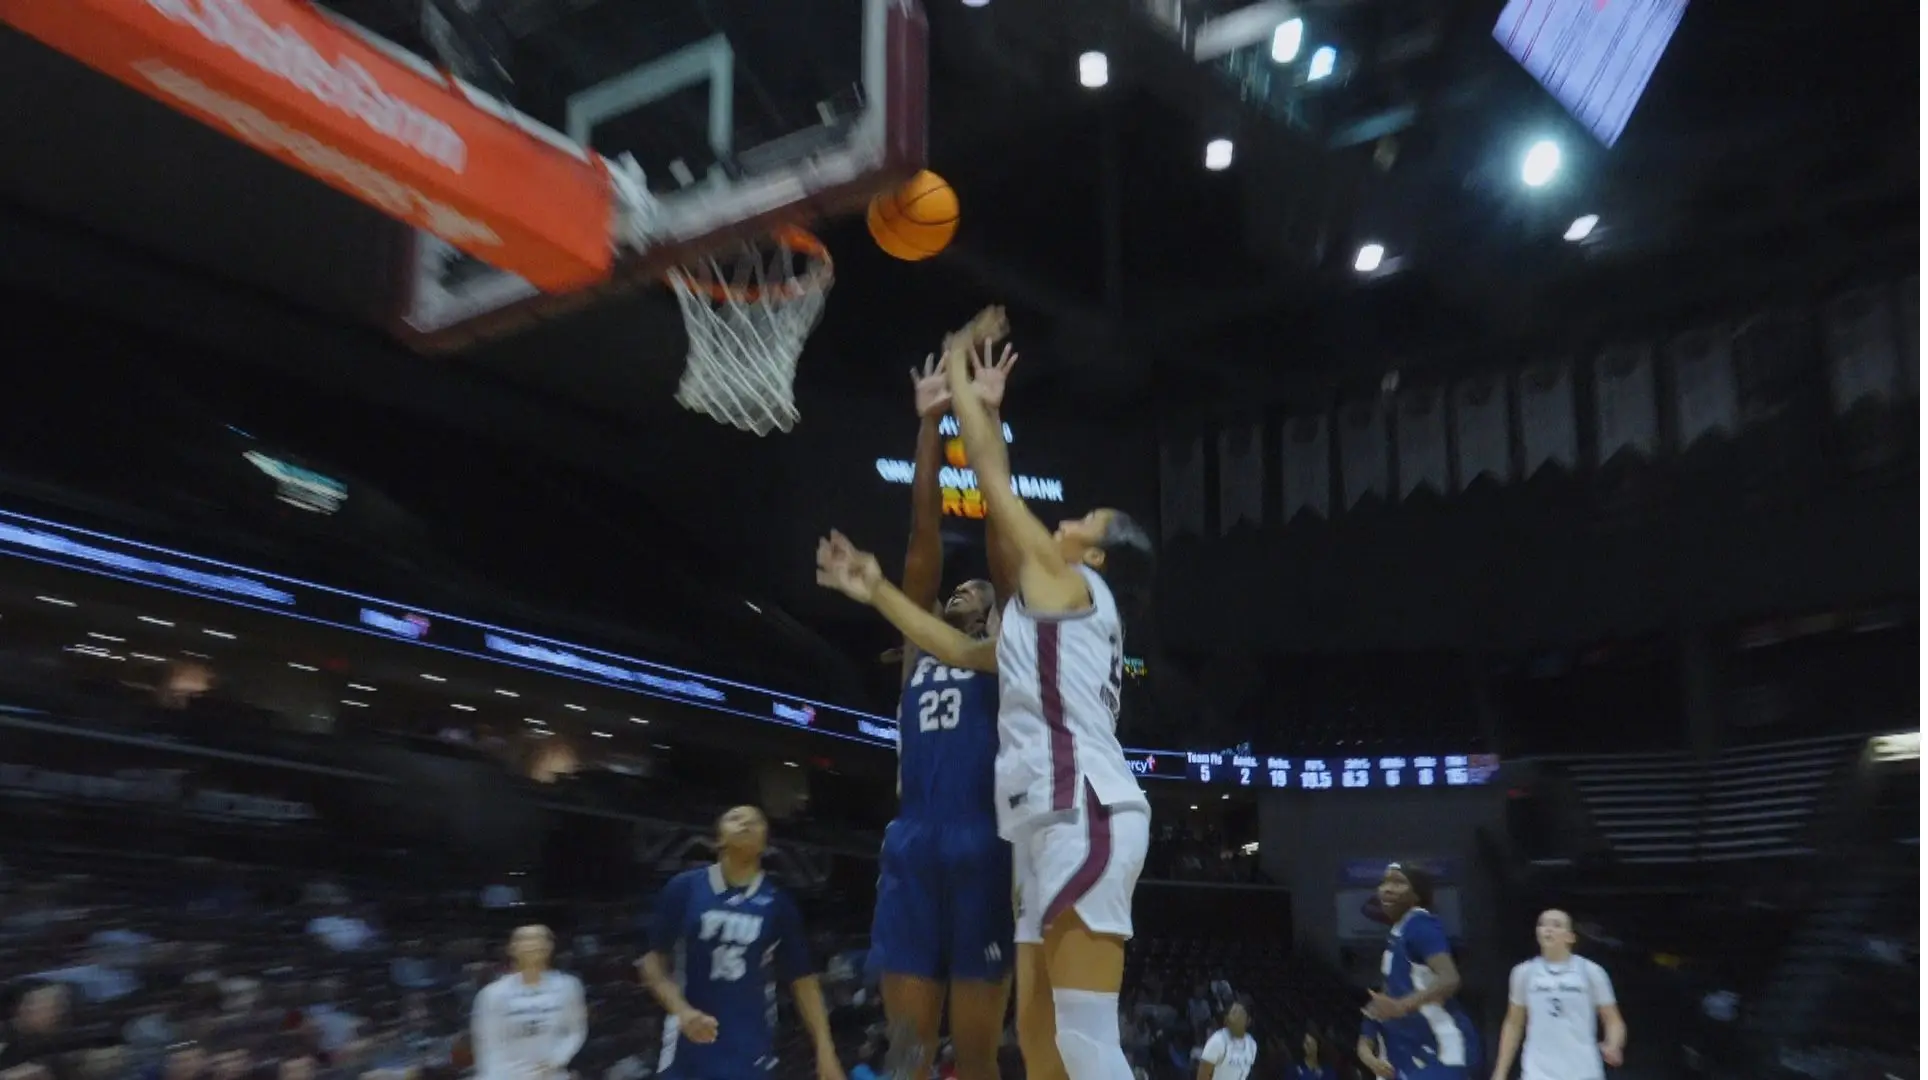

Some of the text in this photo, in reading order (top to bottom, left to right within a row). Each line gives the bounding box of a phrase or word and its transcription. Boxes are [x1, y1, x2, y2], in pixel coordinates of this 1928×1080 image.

[1018, 475, 1064, 502] BANK
[919, 688, 962, 733] 23
[1200, 764, 1211, 783] 5
[1240, 768, 1251, 785] 2
